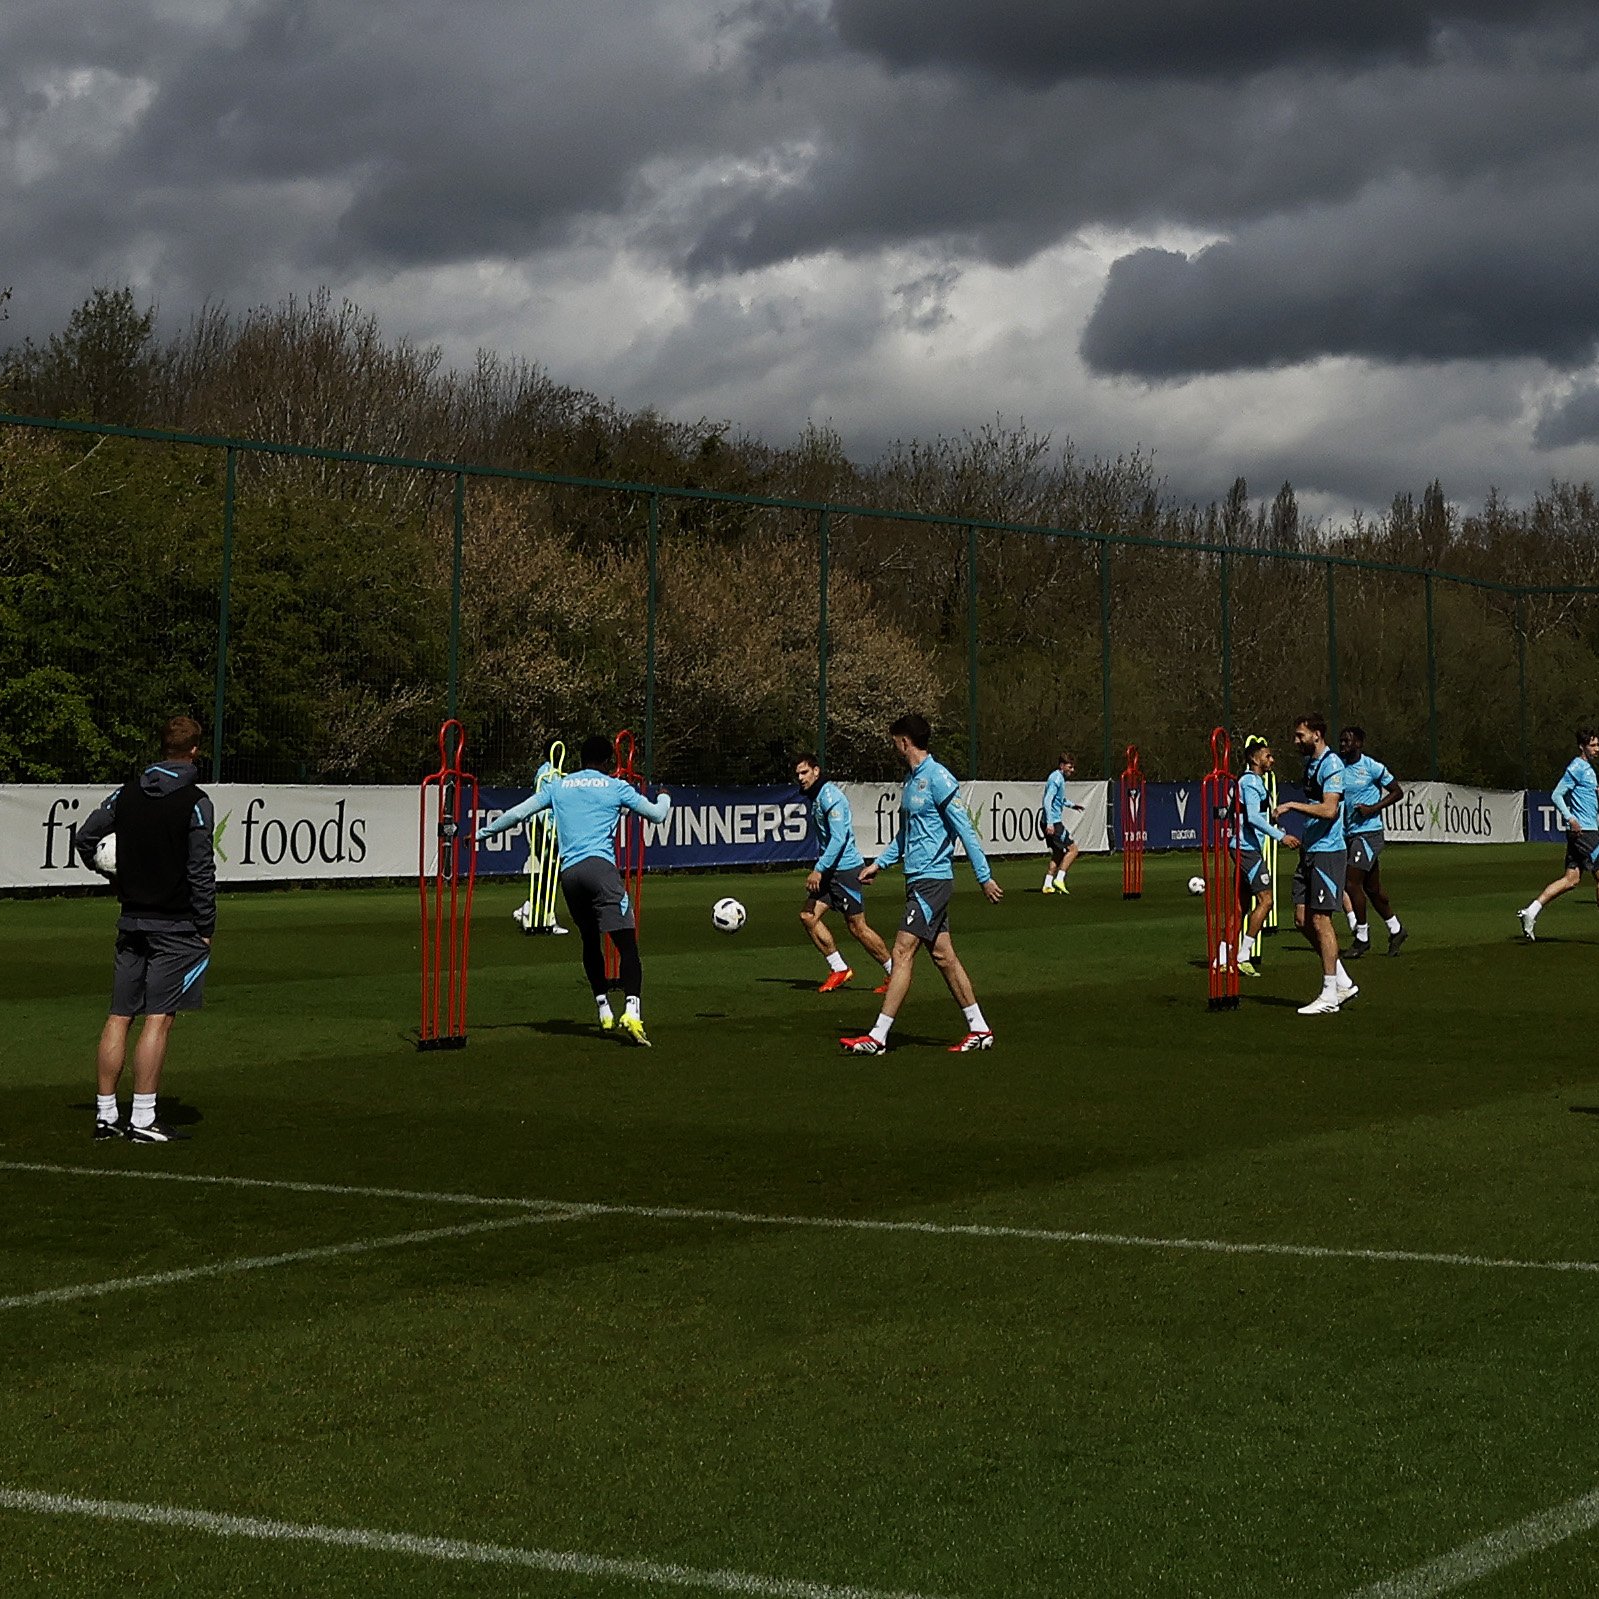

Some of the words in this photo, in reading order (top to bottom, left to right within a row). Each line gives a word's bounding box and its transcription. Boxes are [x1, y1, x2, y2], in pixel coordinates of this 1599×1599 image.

[239, 797, 367, 865] foods
[989, 791, 1046, 842] foo
[1444, 791, 1492, 837] foods
